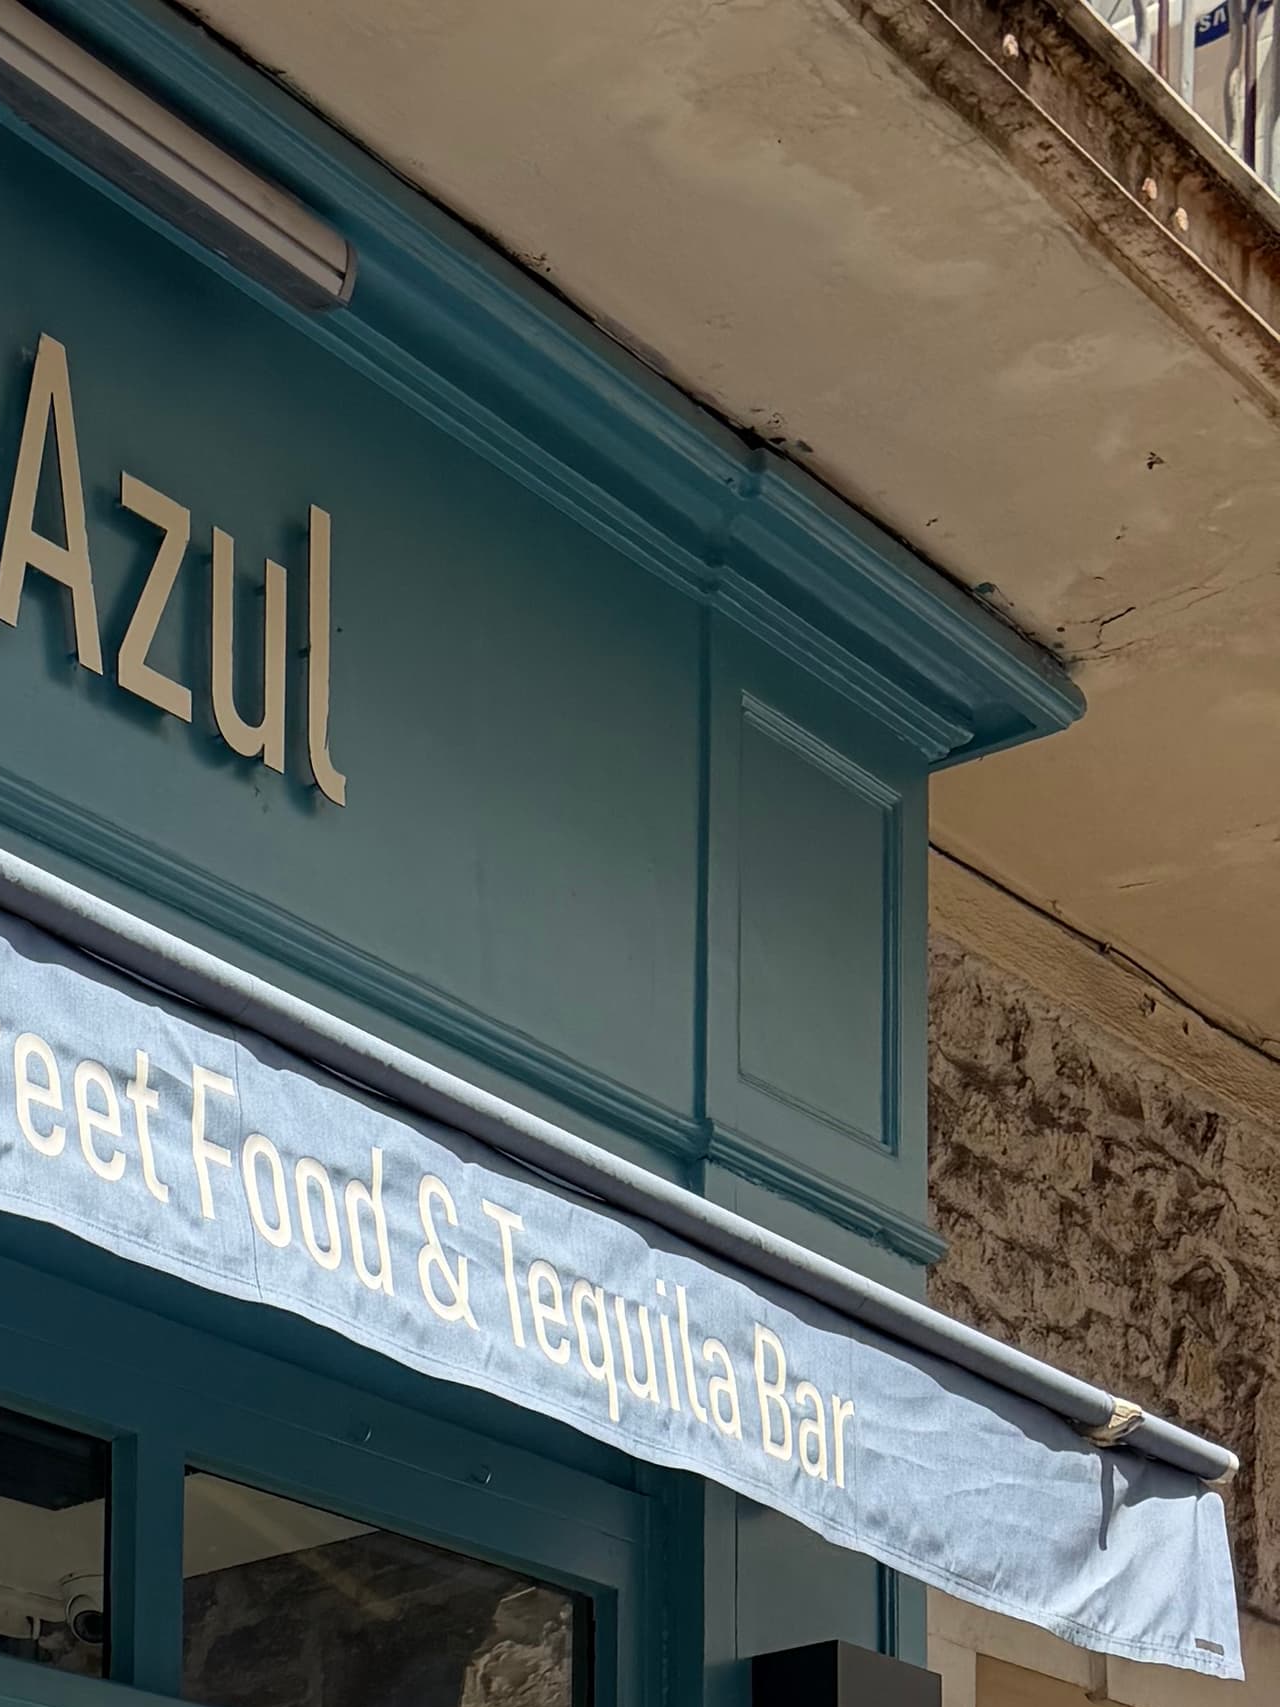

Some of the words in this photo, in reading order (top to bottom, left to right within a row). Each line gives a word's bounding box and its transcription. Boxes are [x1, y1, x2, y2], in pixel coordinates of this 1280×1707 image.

[192, 1063, 394, 1296] Food
[417, 1173, 480, 1333] &
[483, 1198, 744, 1442] Tequila
[752, 1322, 856, 1490] Bar
